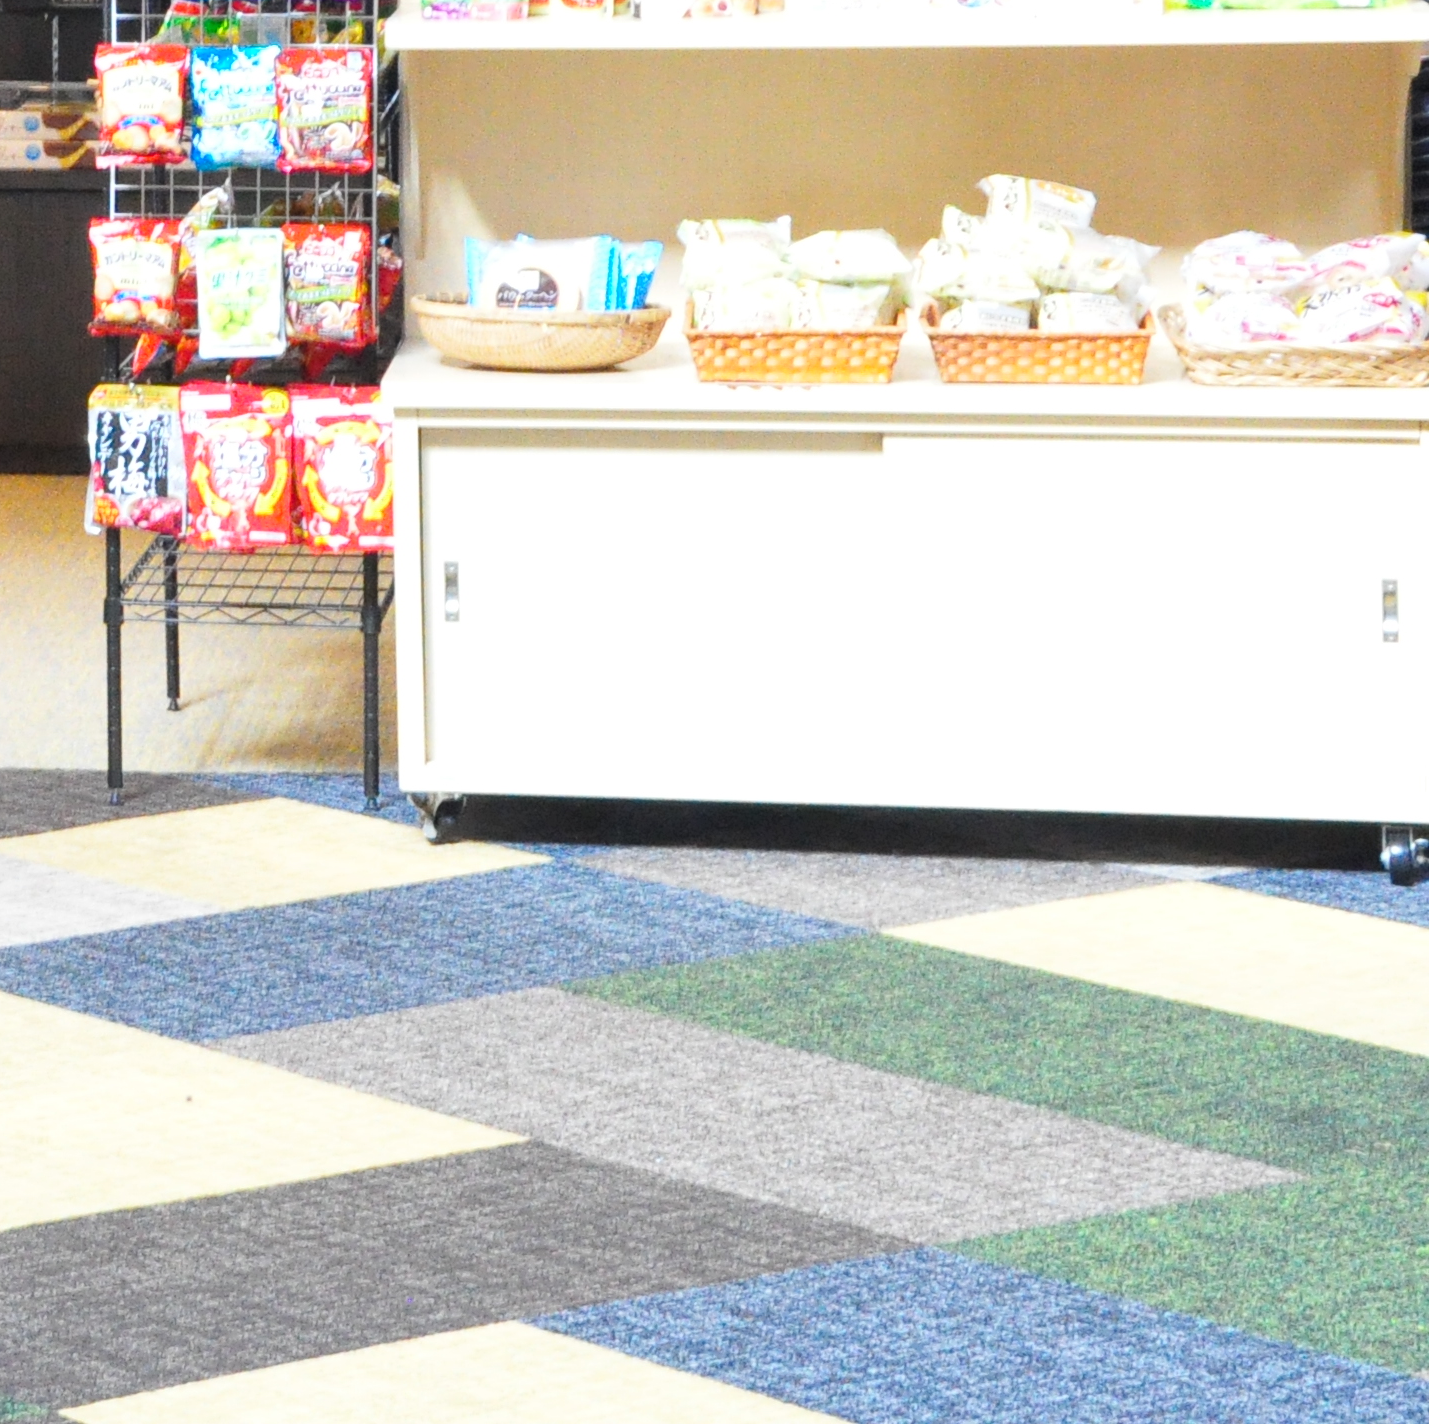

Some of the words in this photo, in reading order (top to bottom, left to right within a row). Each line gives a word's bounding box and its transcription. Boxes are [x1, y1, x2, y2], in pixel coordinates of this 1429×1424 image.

[113, 75, 173, 93] ントリーマアム
